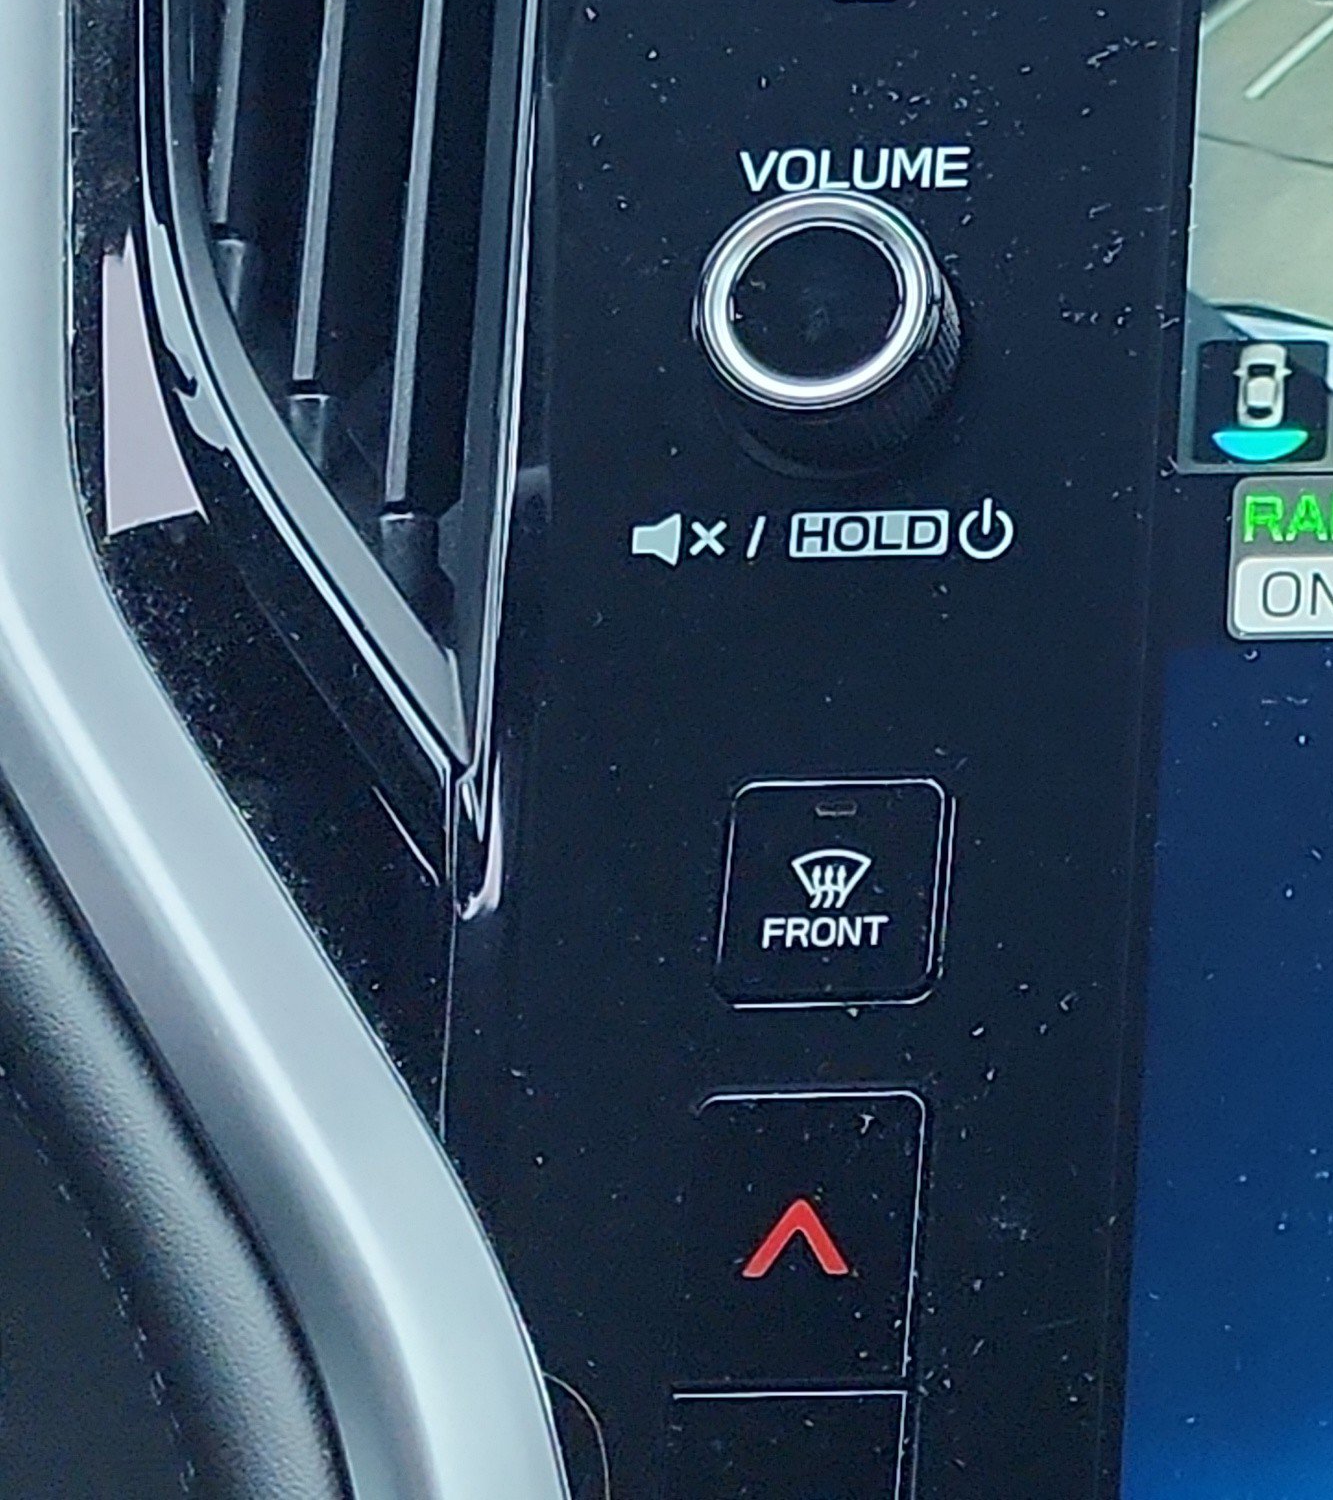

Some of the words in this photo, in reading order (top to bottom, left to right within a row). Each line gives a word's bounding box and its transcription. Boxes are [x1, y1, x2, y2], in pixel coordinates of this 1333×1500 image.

[740, 146, 971, 191] VOLUME
[795, 518, 941, 551] HOLD
[761, 915, 890, 948] FRONT
